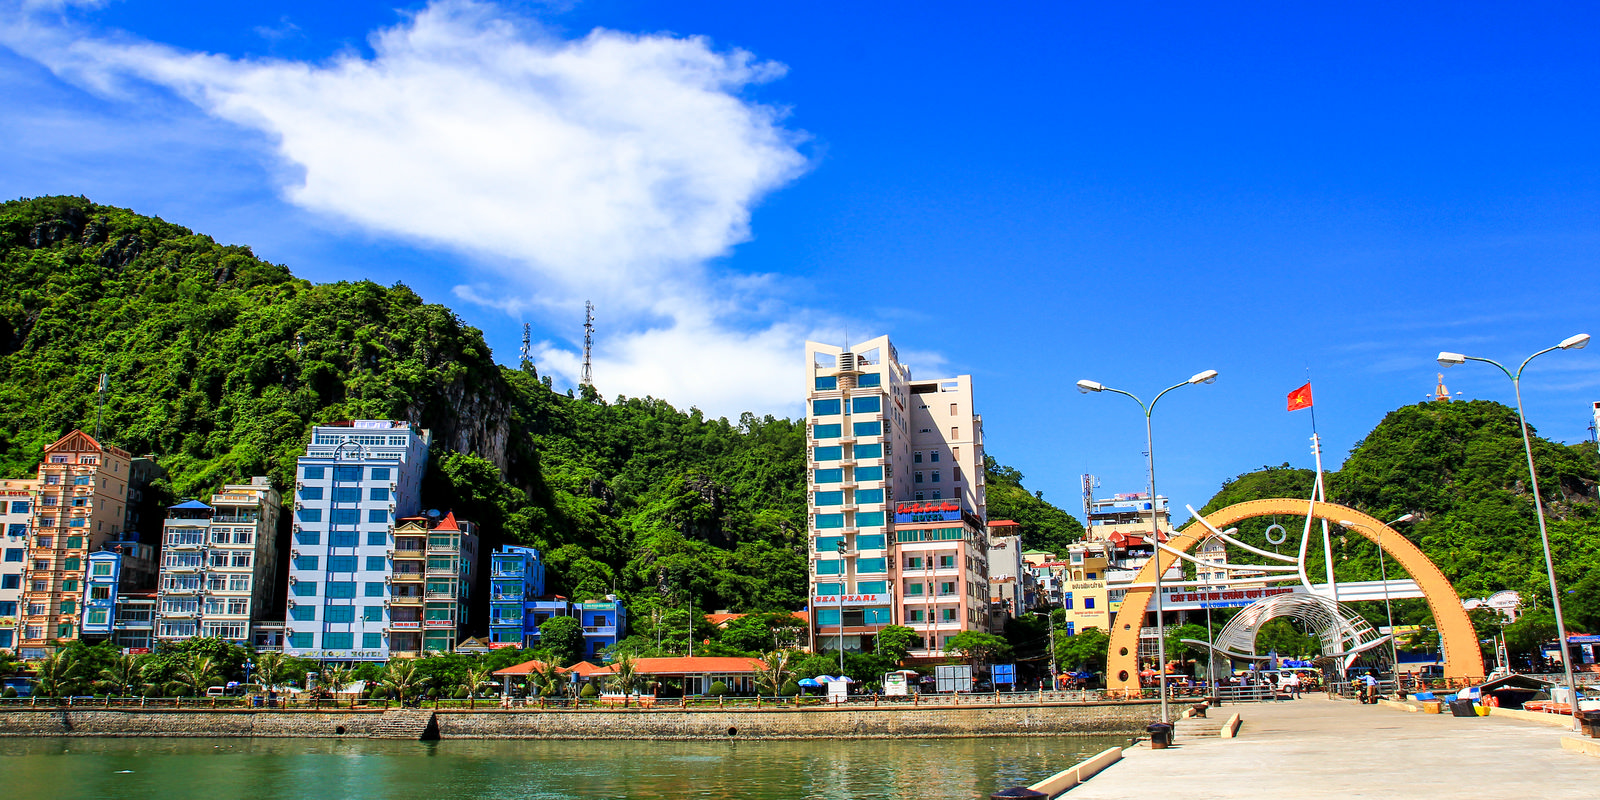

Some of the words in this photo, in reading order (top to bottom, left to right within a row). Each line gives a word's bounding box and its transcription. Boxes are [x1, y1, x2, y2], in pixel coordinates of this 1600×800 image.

[912, 513, 944, 521] HOTEL
[841, 594, 877, 602] PEARL
[1170, 592, 1185, 602] CÁT
[1187, 591, 1199, 601] BÀ
[1200, 593, 1220, 601] KNH
[1222, 589, 1244, 600] CHÀO
[1246, 588, 1263, 599] QUÝ
